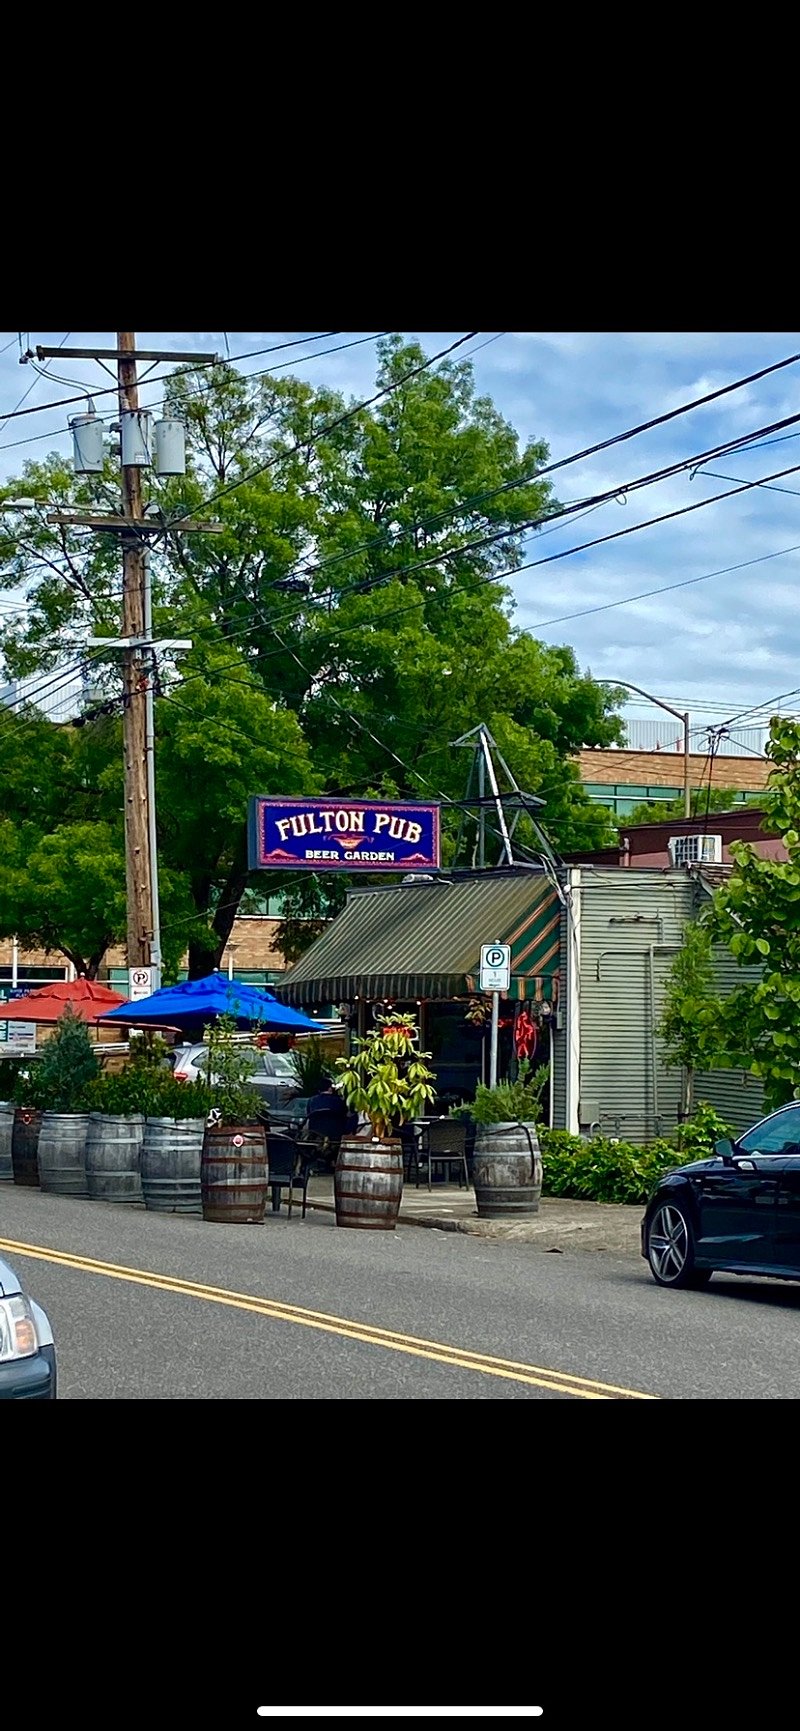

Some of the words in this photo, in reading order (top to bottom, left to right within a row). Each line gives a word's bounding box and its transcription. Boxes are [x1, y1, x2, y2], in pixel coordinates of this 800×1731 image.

[275, 810, 365, 841] FULTON
[373, 813, 422, 843] PUB
[305, 849, 339, 860] BEER
[344, 850, 395, 861] GARDEN
[492, 952, 501, 963] P
